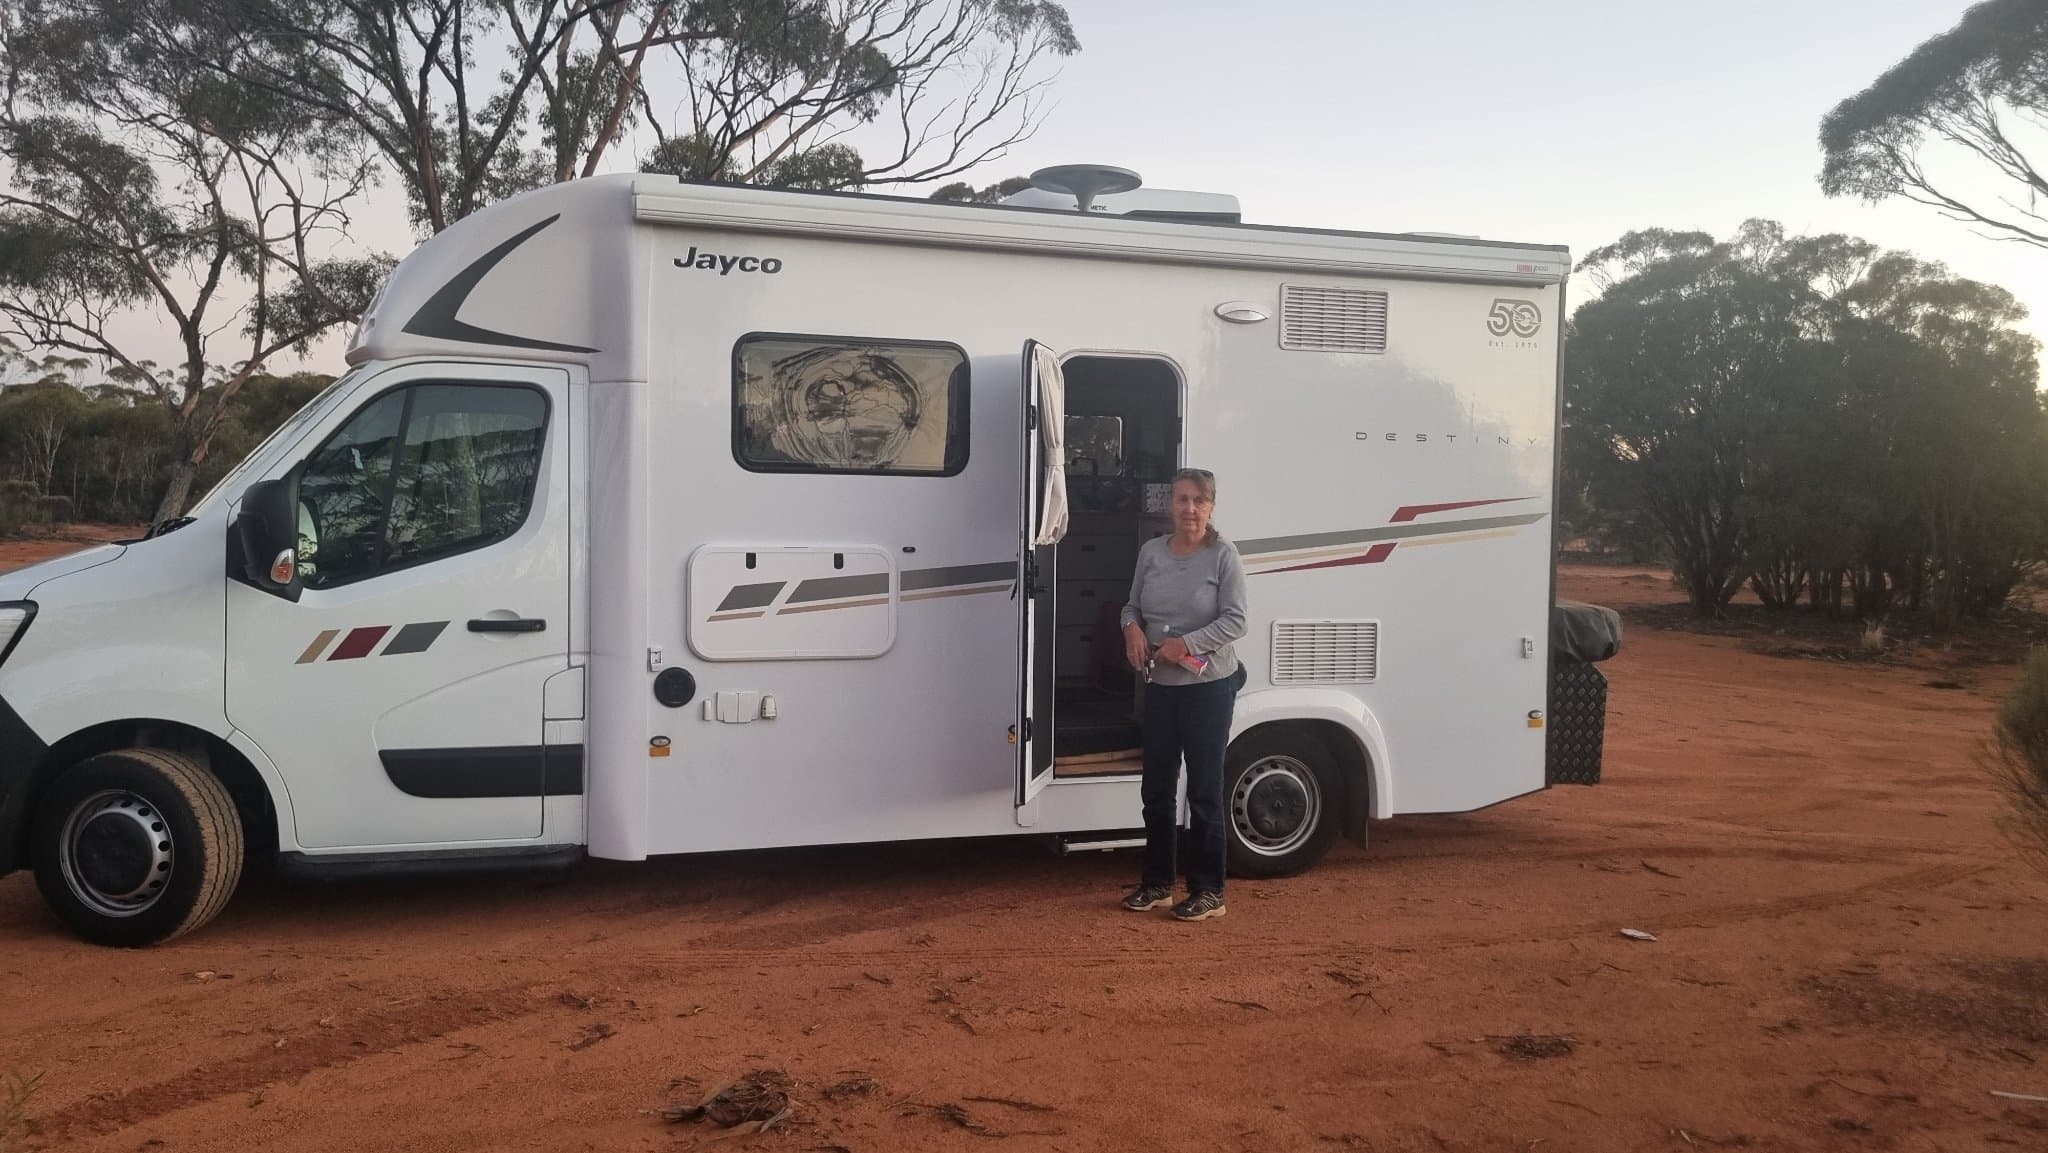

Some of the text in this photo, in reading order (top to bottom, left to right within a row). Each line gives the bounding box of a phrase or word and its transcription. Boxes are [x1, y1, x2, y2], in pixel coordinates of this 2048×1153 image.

[673, 246, 782, 276] Jayco
[1487, 298, 1541, 338] 50
[1355, 431, 1537, 445] DESTINY
